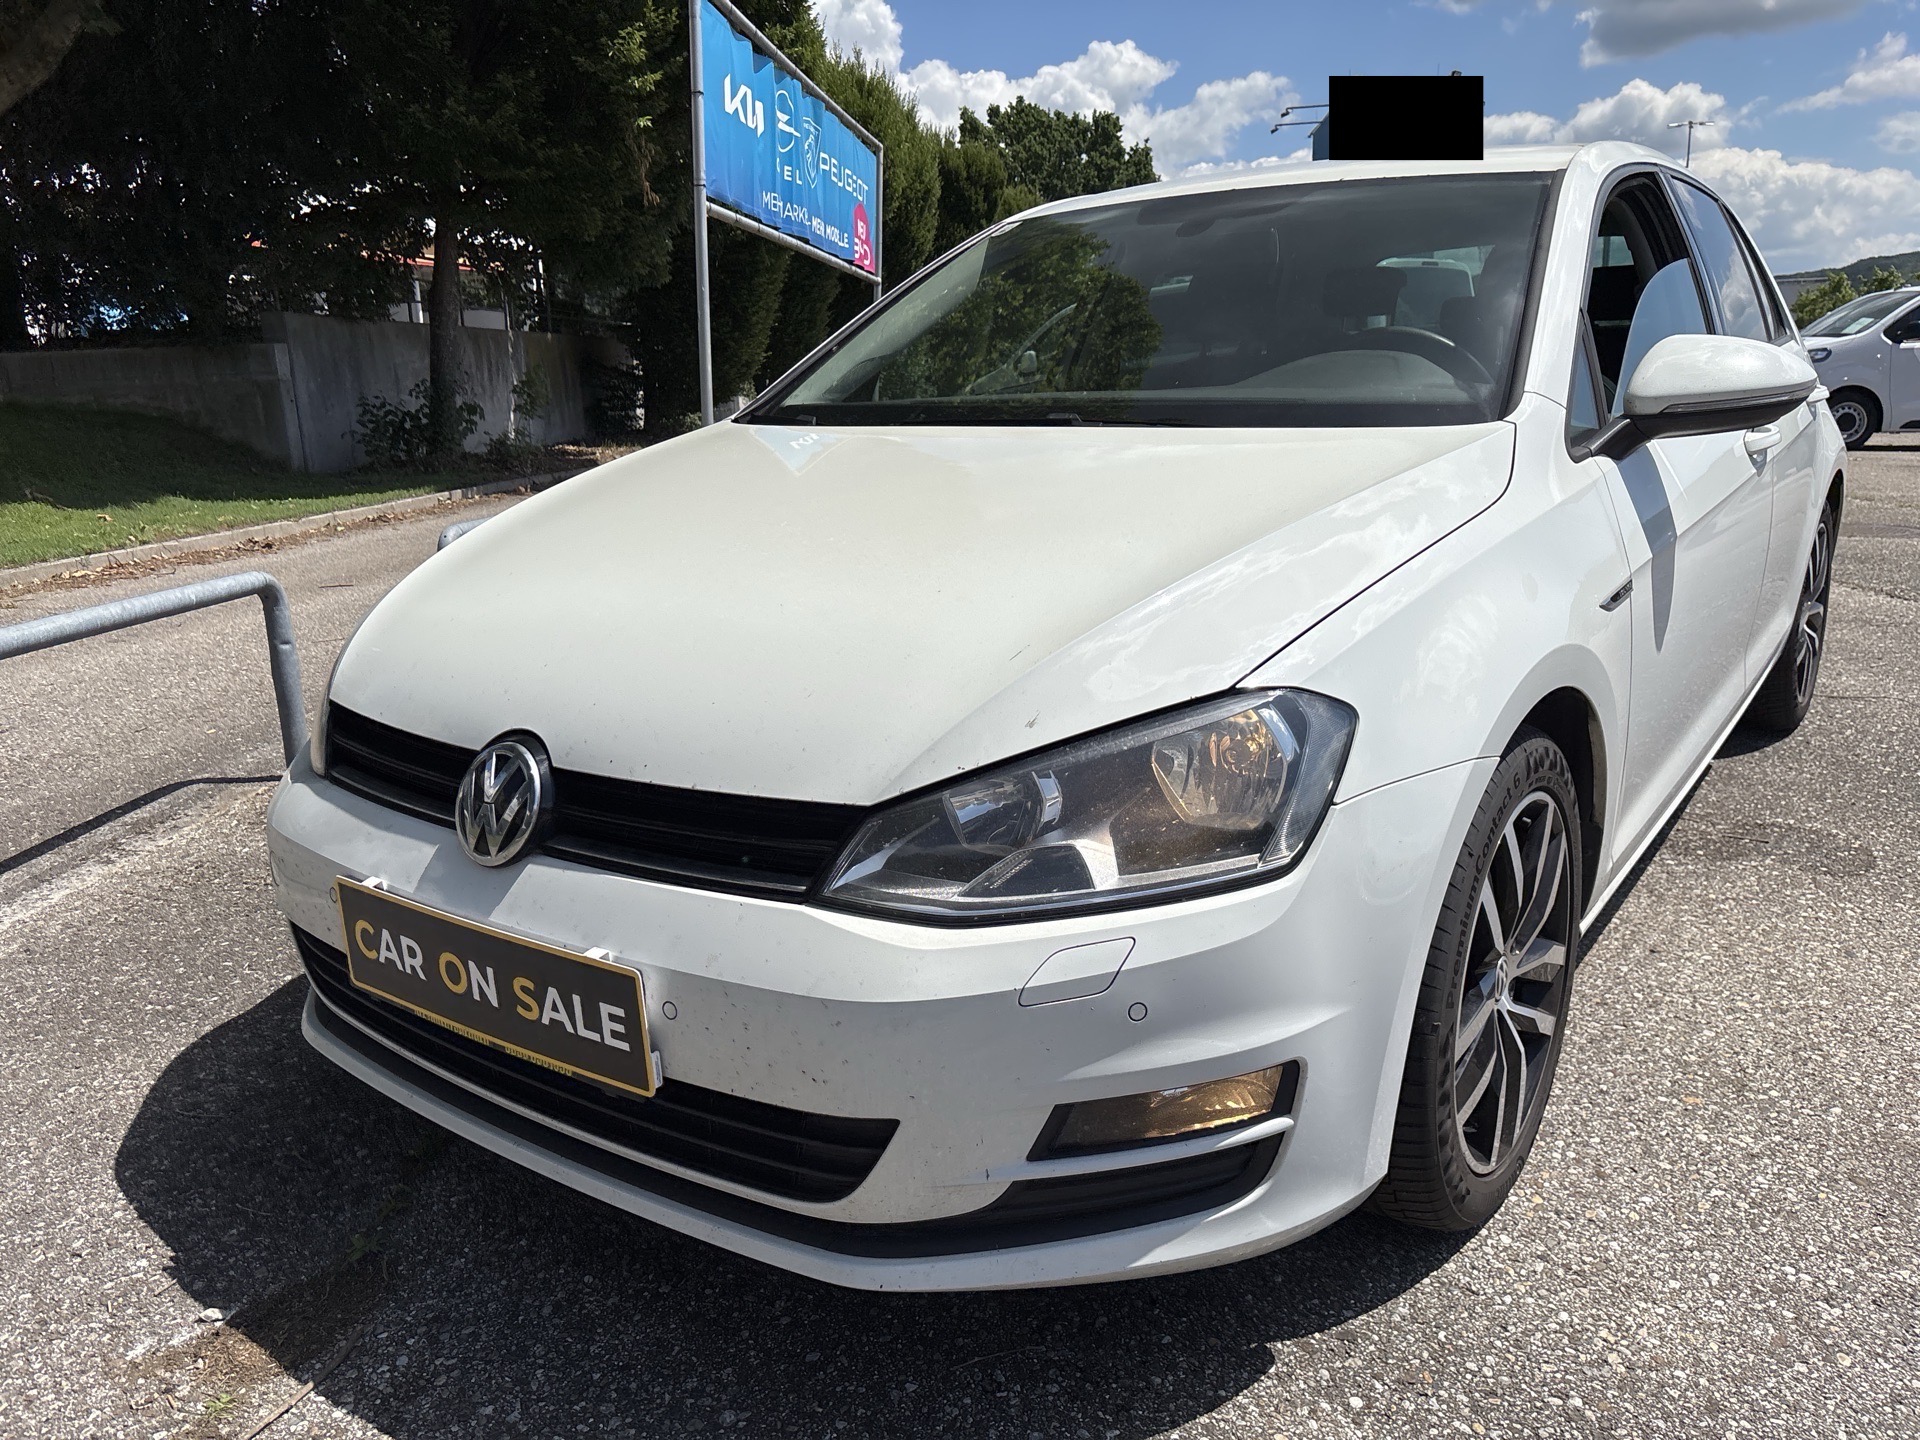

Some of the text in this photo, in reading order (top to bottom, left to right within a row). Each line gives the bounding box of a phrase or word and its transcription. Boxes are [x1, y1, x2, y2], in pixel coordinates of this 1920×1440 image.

[1446, 772, 1521, 1009] PremiumContact 6
[355, 920, 427, 981] CAR
[438, 952, 499, 1009] ON
[512, 976, 631, 1052] SALE
